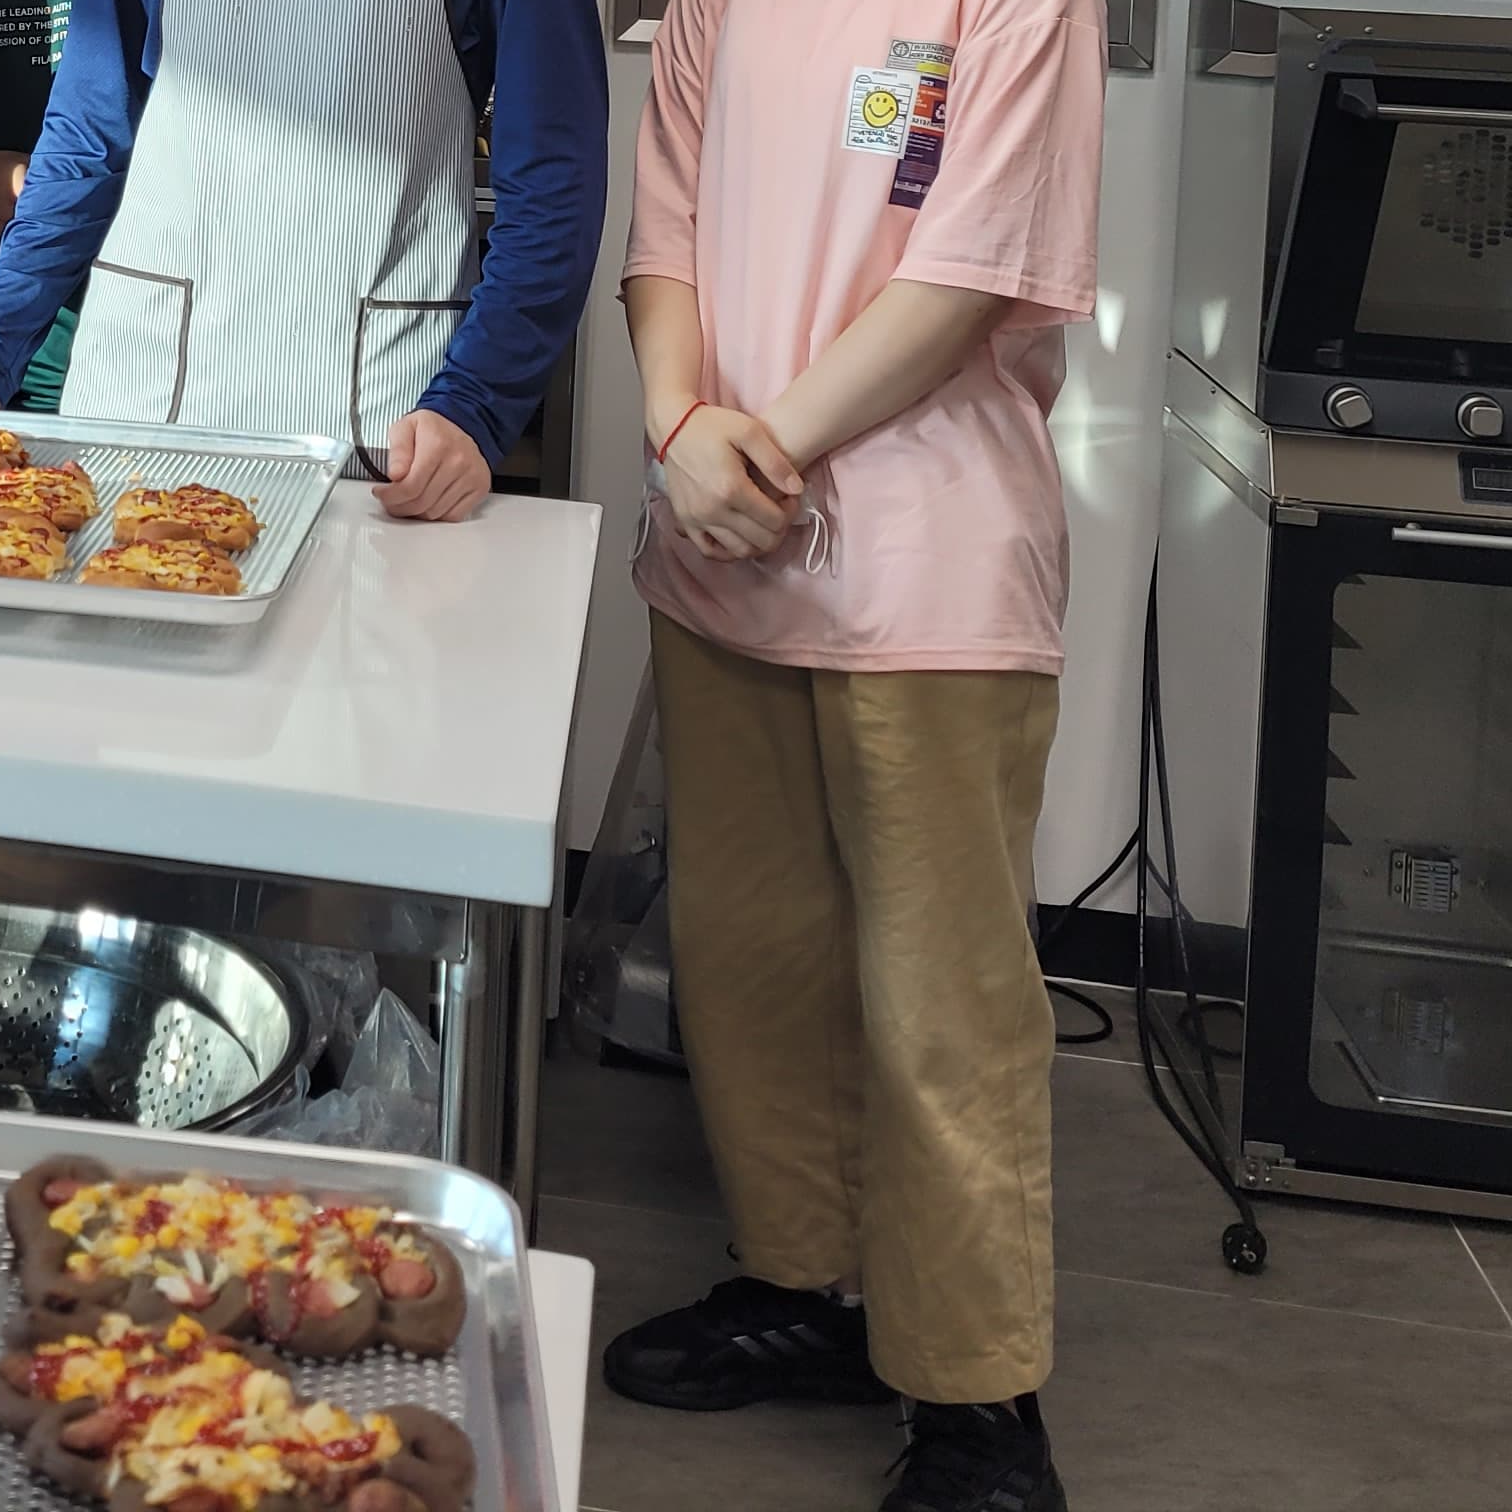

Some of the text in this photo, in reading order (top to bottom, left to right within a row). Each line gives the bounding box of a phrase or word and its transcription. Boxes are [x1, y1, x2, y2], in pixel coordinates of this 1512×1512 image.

[9, 6, 51, 17] LEADING
[51, 1, 72, 14] AUTH
[18, 22, 32, 31] BY
[34, 21, 53, 30] THE
[28, 35, 43, 45] OF
